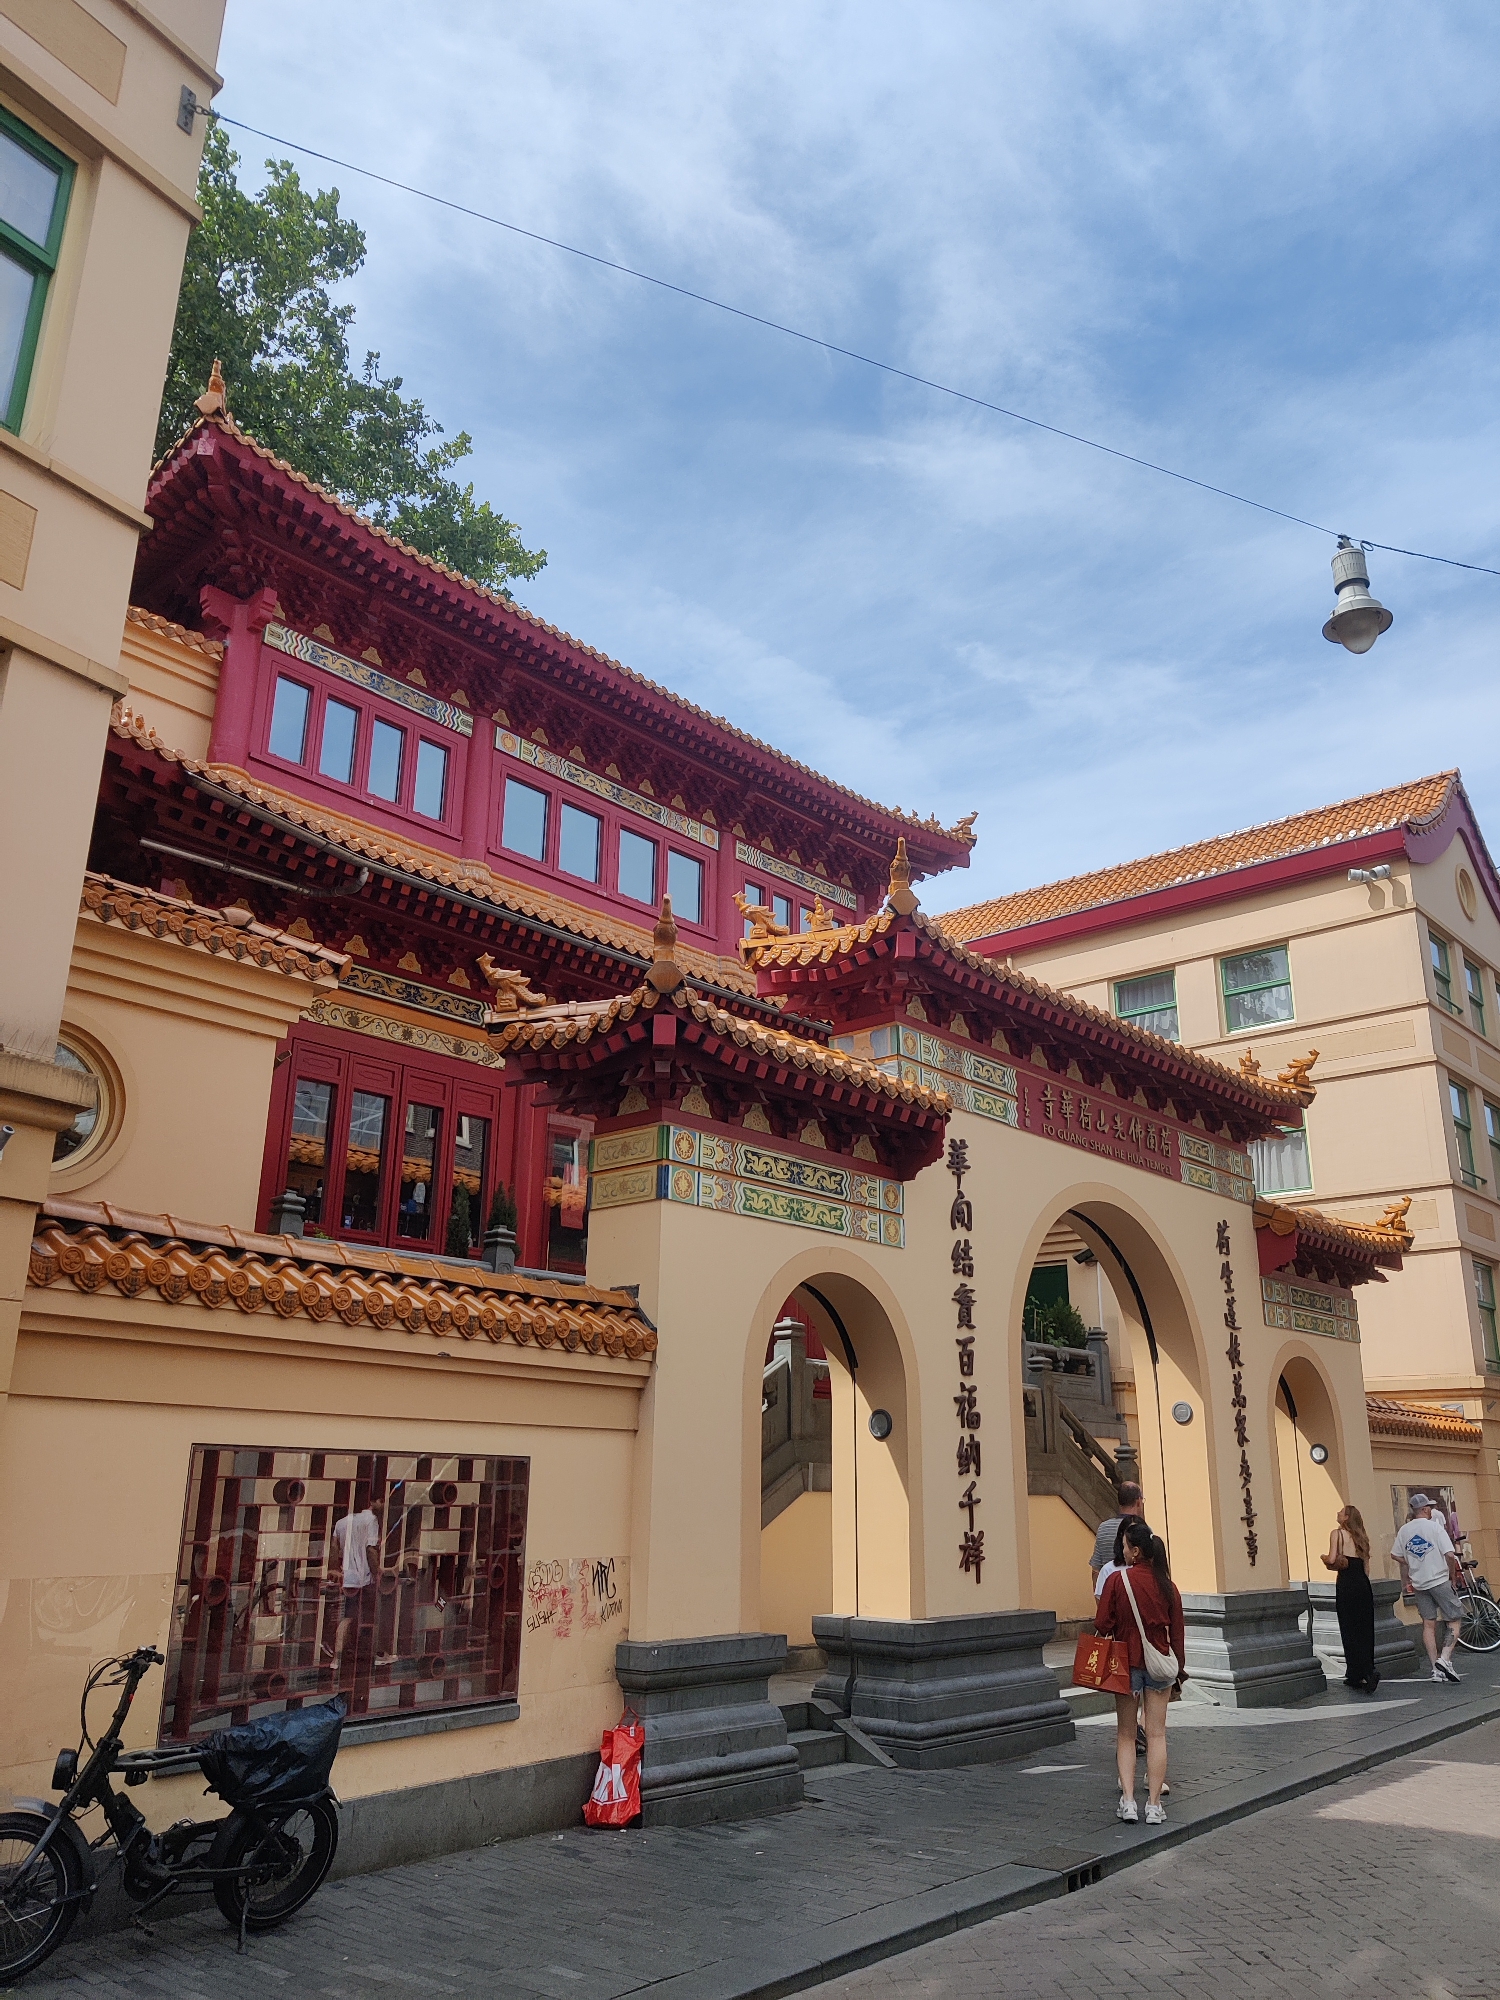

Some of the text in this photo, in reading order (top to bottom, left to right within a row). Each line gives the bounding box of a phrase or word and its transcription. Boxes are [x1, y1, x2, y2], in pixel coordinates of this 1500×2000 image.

[1043, 1123, 1173, 1176] FO GUANG SHAN HE HUA TEMPEL
